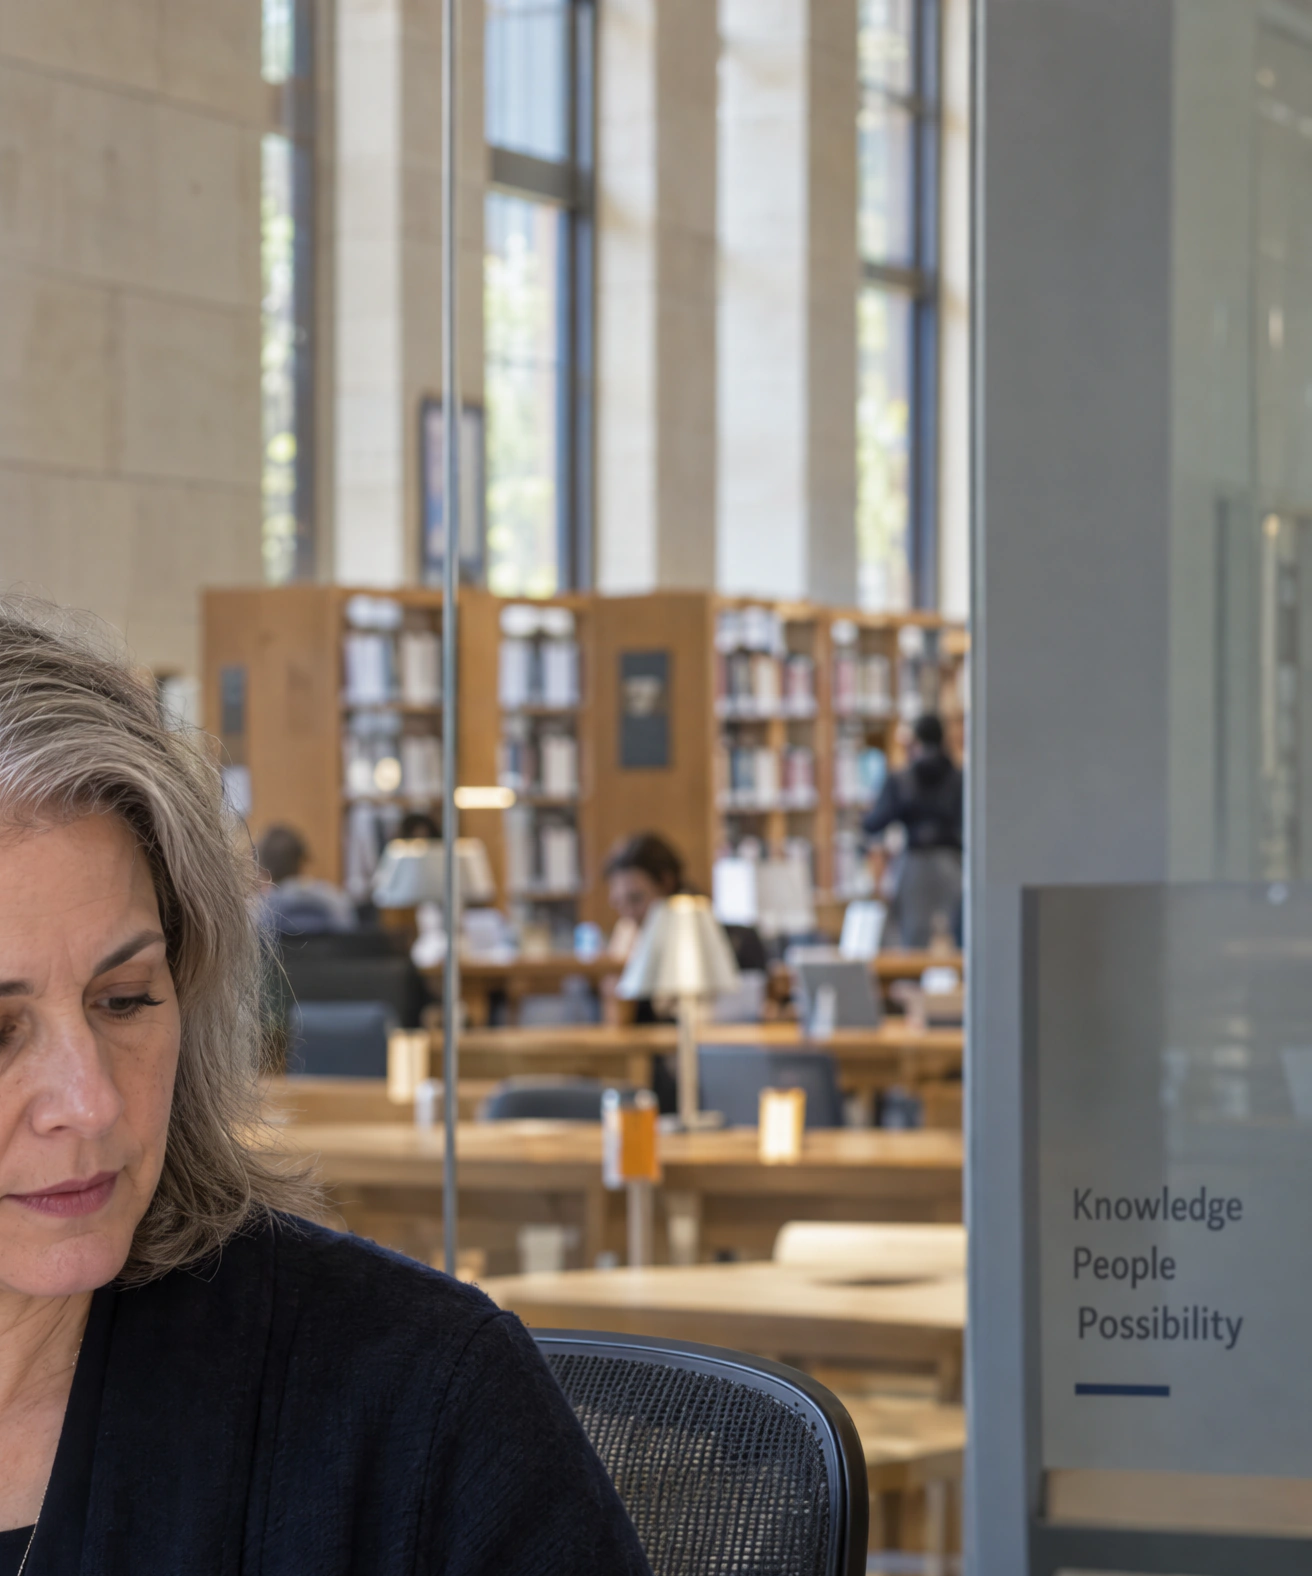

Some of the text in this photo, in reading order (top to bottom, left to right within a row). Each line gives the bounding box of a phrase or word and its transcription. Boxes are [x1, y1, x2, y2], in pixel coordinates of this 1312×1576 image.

[1073, 1185, 1243, 1231] Knowledge
[1073, 1245, 1176, 1289] People
[1078, 1305, 1244, 1350] Possibility
